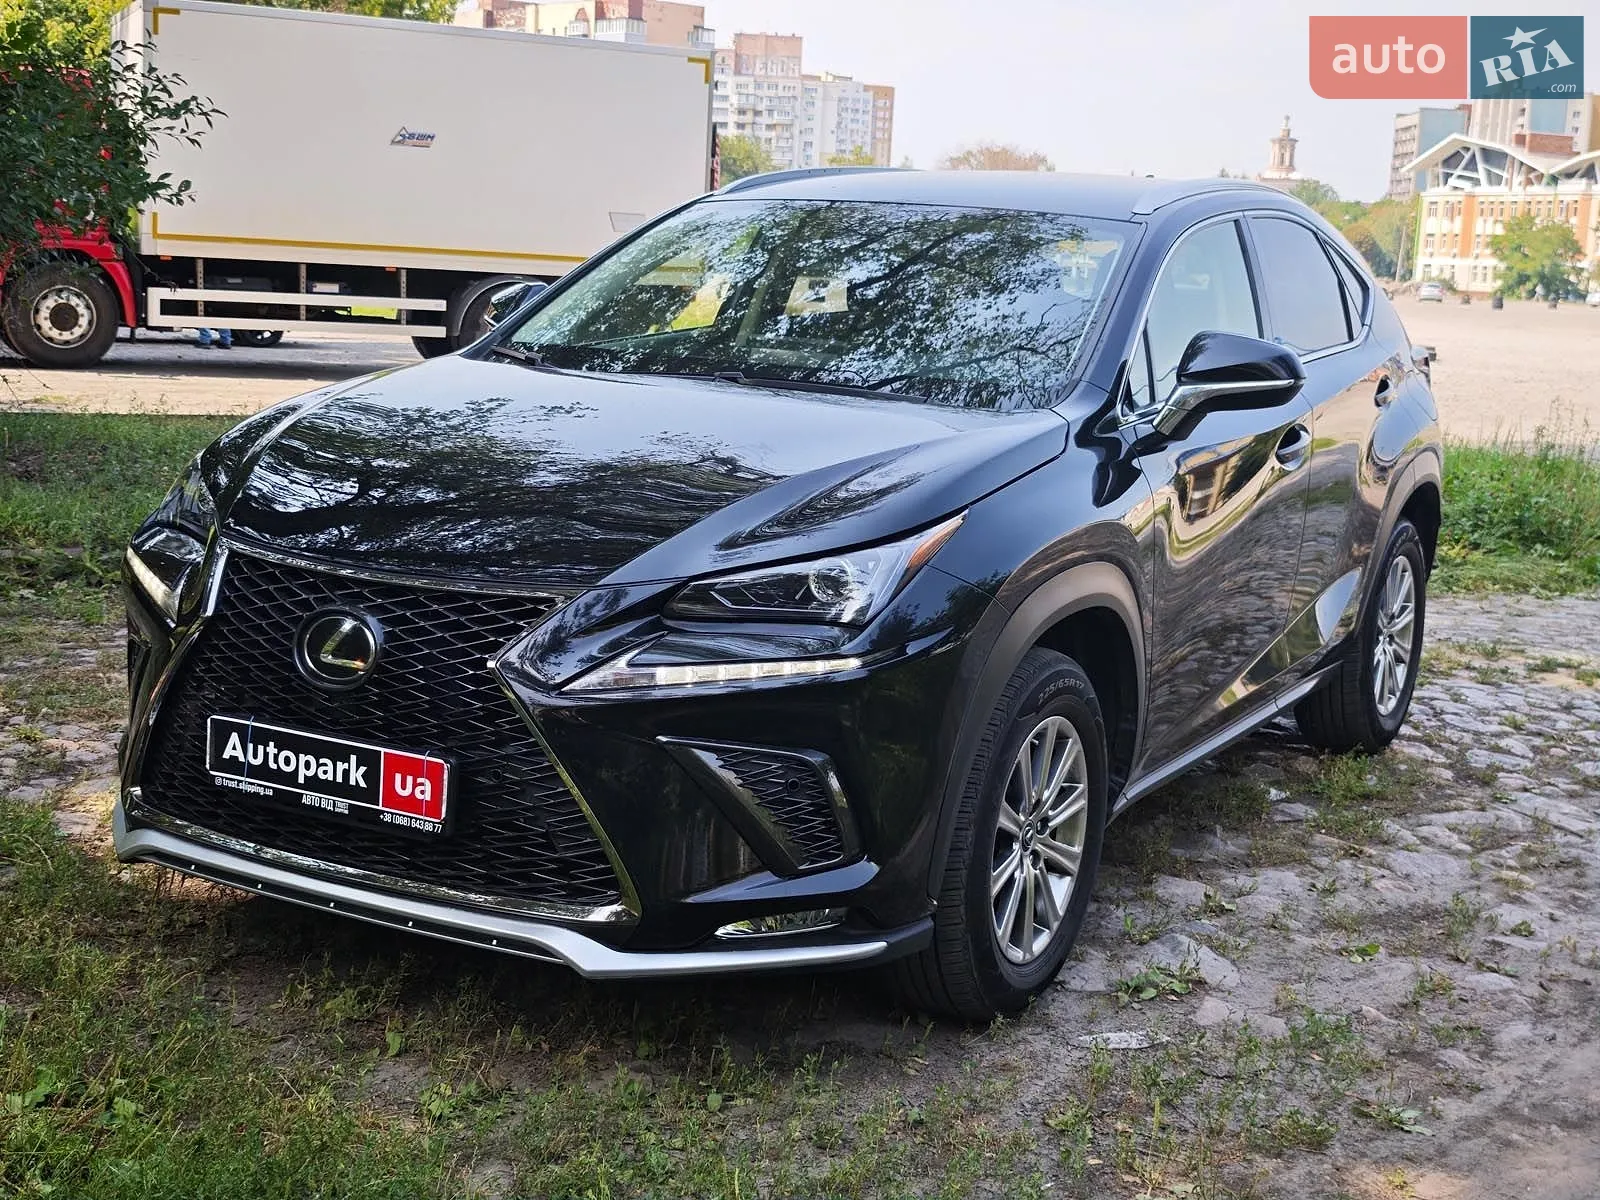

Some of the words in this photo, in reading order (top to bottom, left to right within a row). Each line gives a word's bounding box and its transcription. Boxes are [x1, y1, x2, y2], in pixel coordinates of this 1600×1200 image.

[222, 731, 368, 788] Autopark
[395, 772, 432, 801] ua
[301, 793, 320, 806] АВТО
[379, 812, 392, 822] +38
[392, 815, 411, 827] (068)
[411, 819, 424, 830] 643
[433, 824, 442, 833] 77
